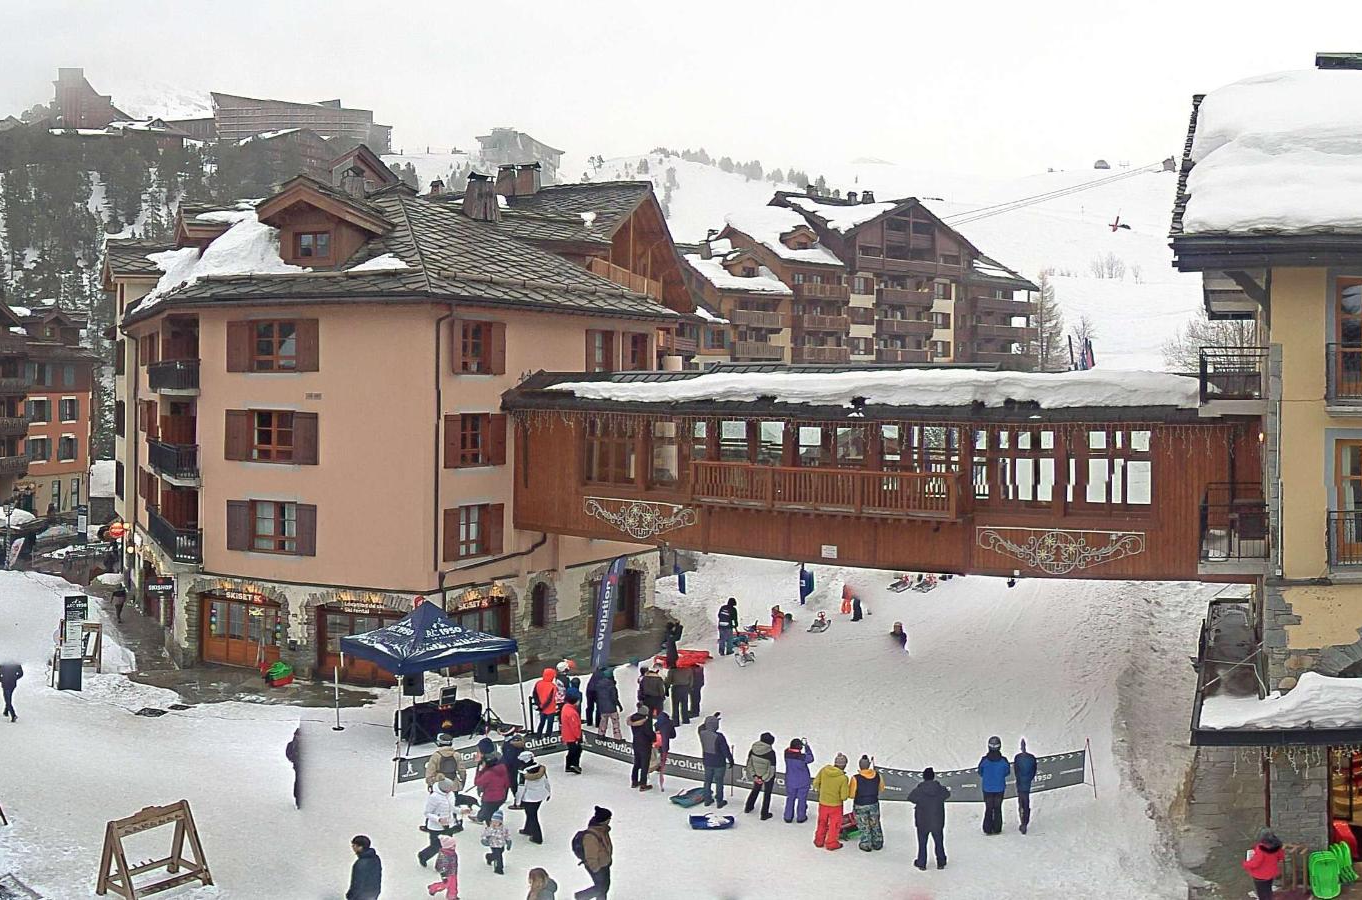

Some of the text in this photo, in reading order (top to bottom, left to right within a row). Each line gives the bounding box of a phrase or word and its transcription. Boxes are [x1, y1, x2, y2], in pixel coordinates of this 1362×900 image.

[148, 584, 173, 592] SKISHOP
[225, 591, 252, 601] SKISET
[596, 580, 612, 651] evolution
[439, 626, 462, 636] 1950
